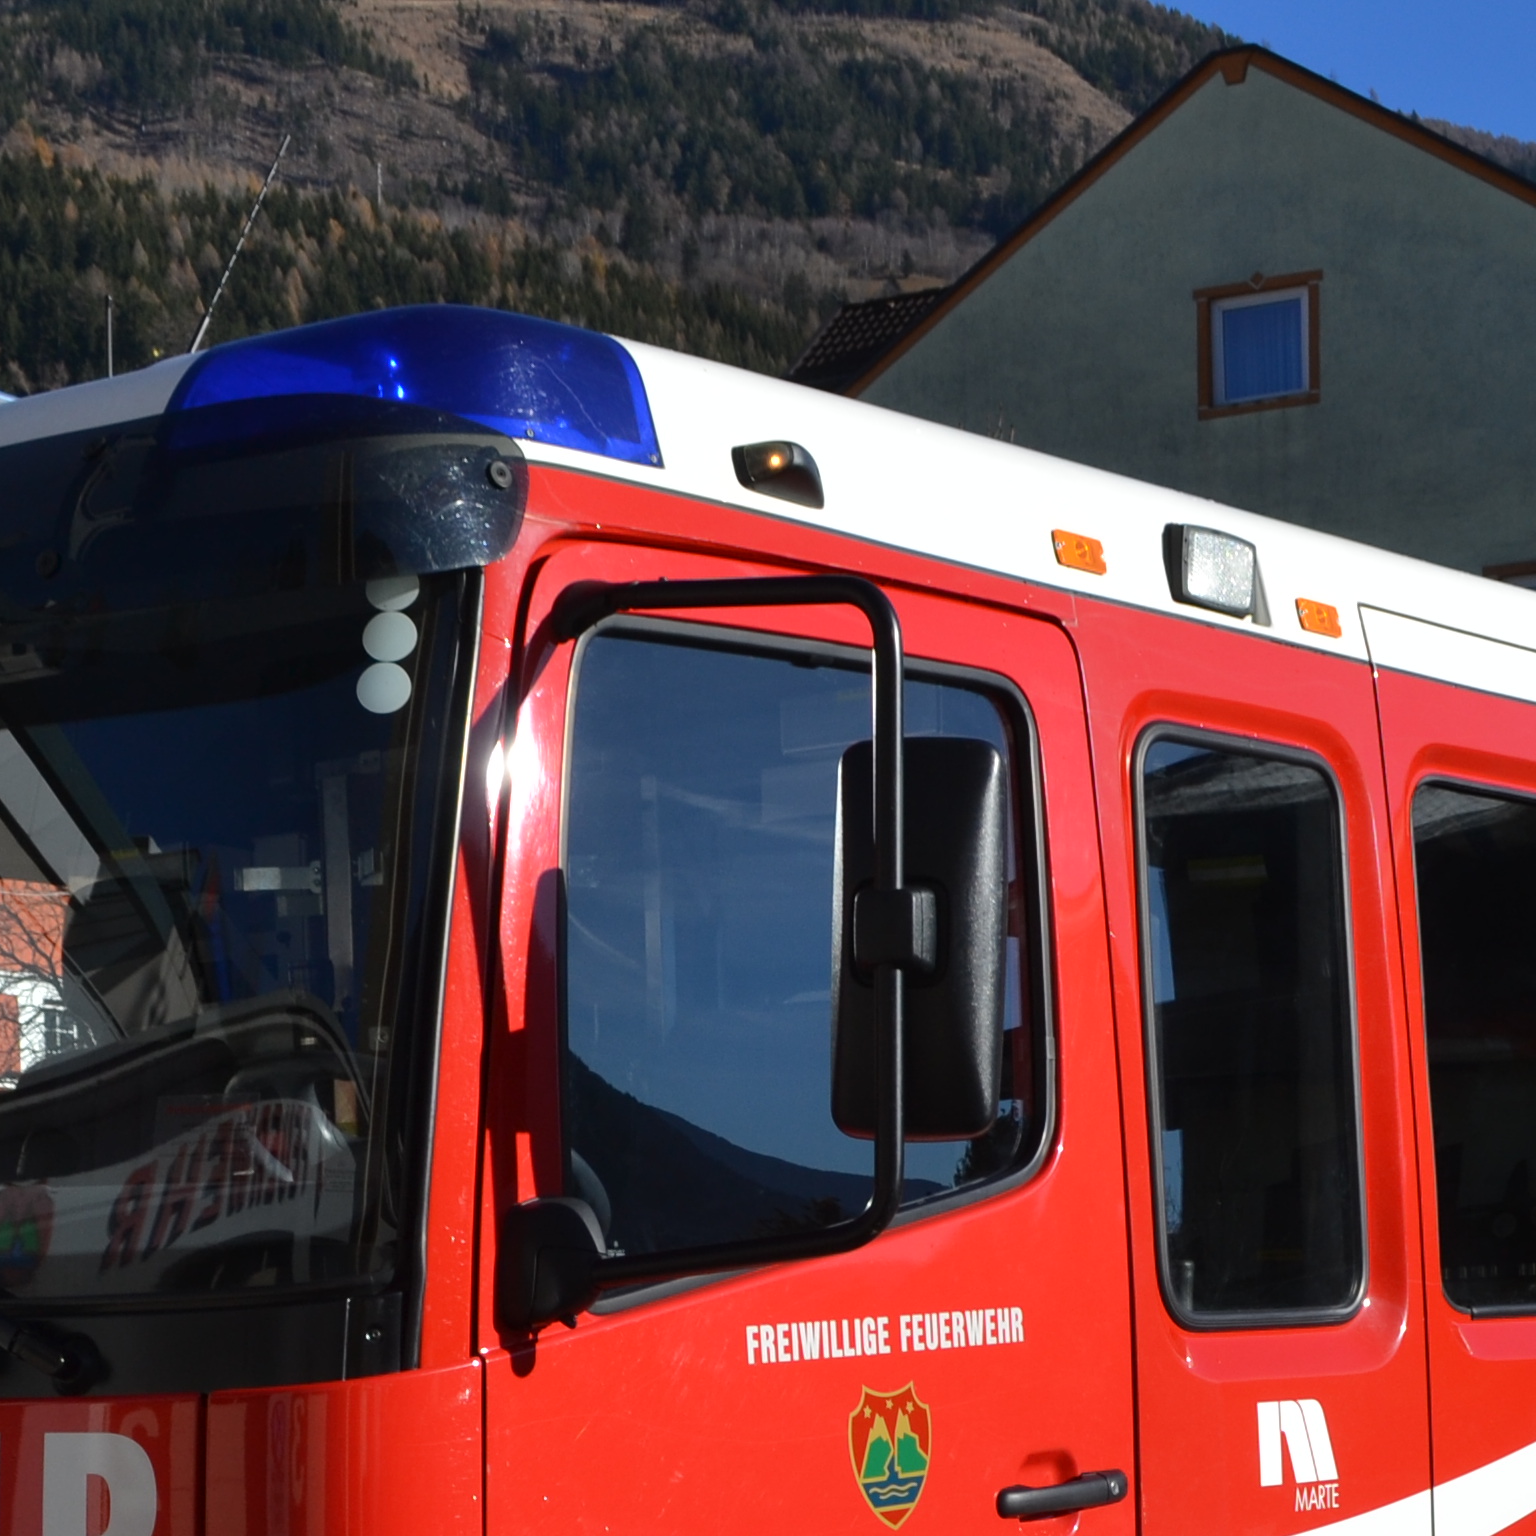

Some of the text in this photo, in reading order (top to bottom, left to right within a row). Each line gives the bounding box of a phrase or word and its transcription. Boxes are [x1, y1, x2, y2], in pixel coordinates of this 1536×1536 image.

[746, 1306, 1024, 1365] FREIWILLIGE FEUERWEHR
[1295, 1483, 1339, 1512] MARTE
